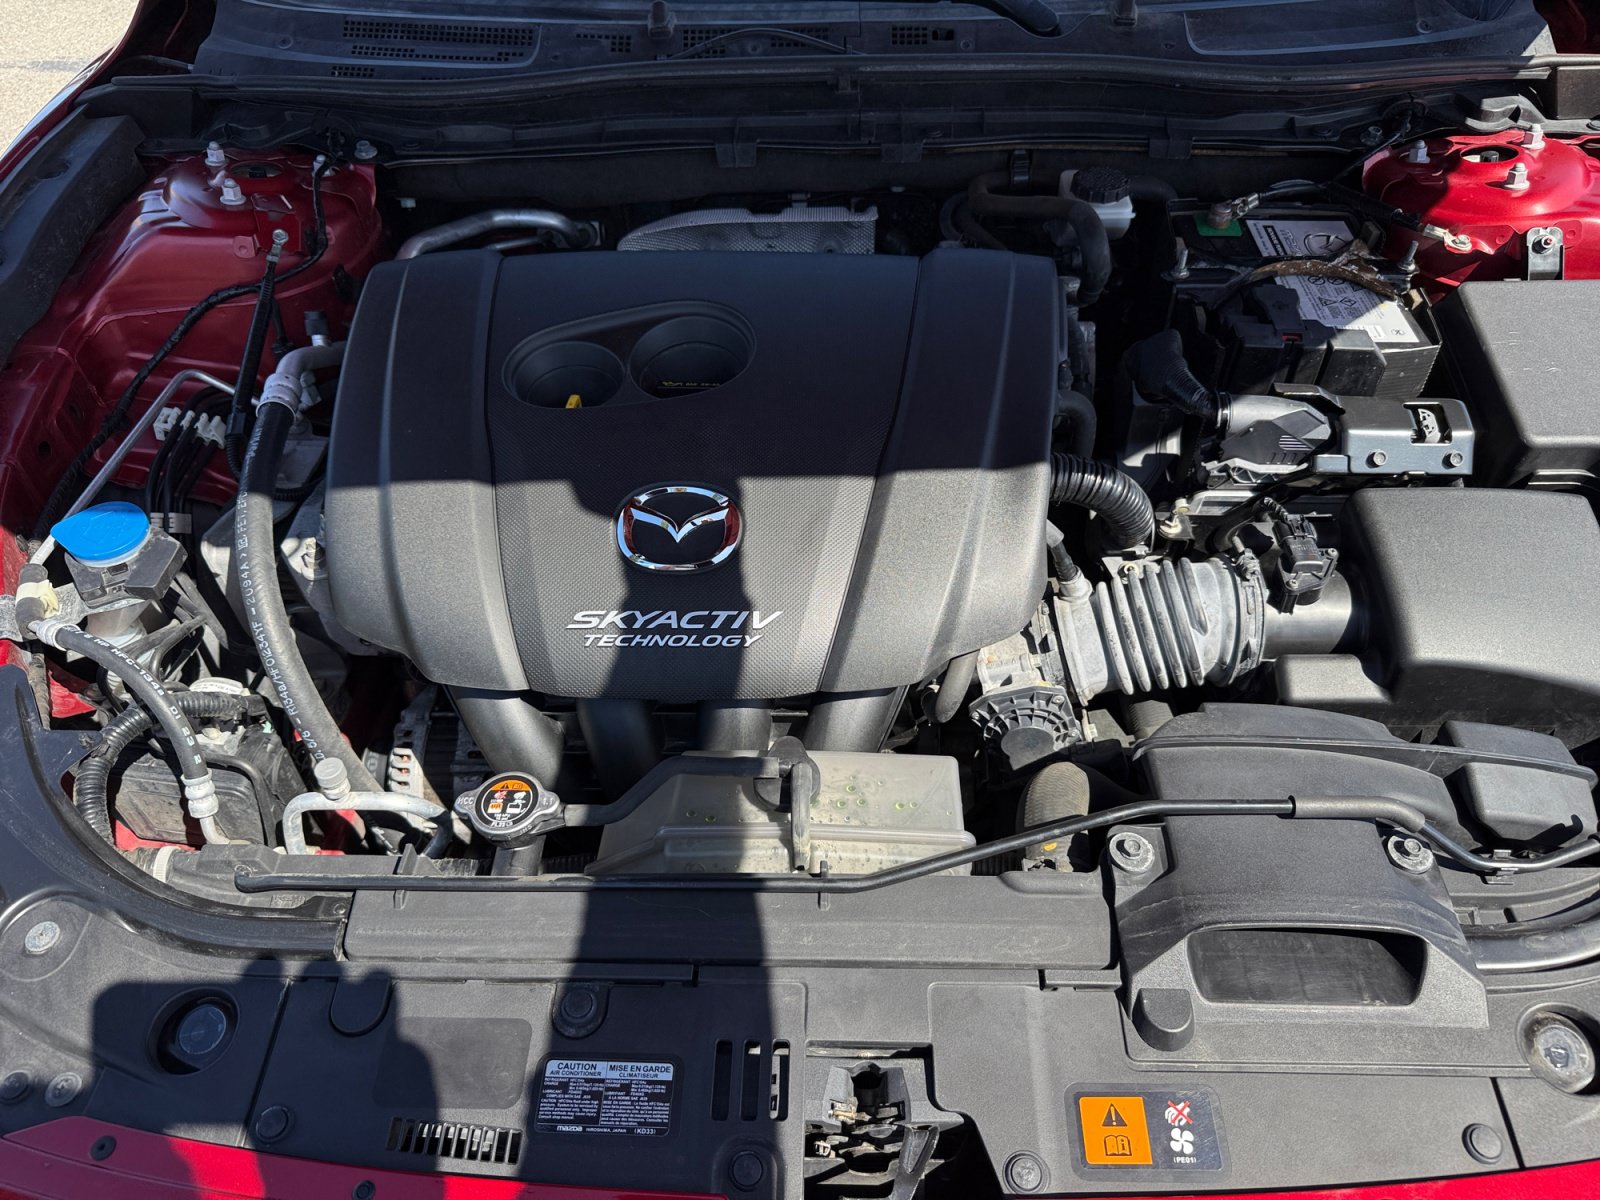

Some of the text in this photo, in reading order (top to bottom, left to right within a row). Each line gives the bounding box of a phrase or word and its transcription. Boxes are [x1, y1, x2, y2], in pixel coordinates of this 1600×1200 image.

[566, 610, 784, 630] SKYACTIV
[583, 634, 763, 648] TECHNOLOGY
[251, 620, 299, 717] R134a/HFO1234YF
[557, 1062, 598, 1071] CAUTION
[608, 1064, 629, 1072] MISE
[642, 1065, 672, 1074] GARDE
[632, 1127, 656, 1135] (KD33)
[1173, 1156, 1197, 1164] (PE01)
